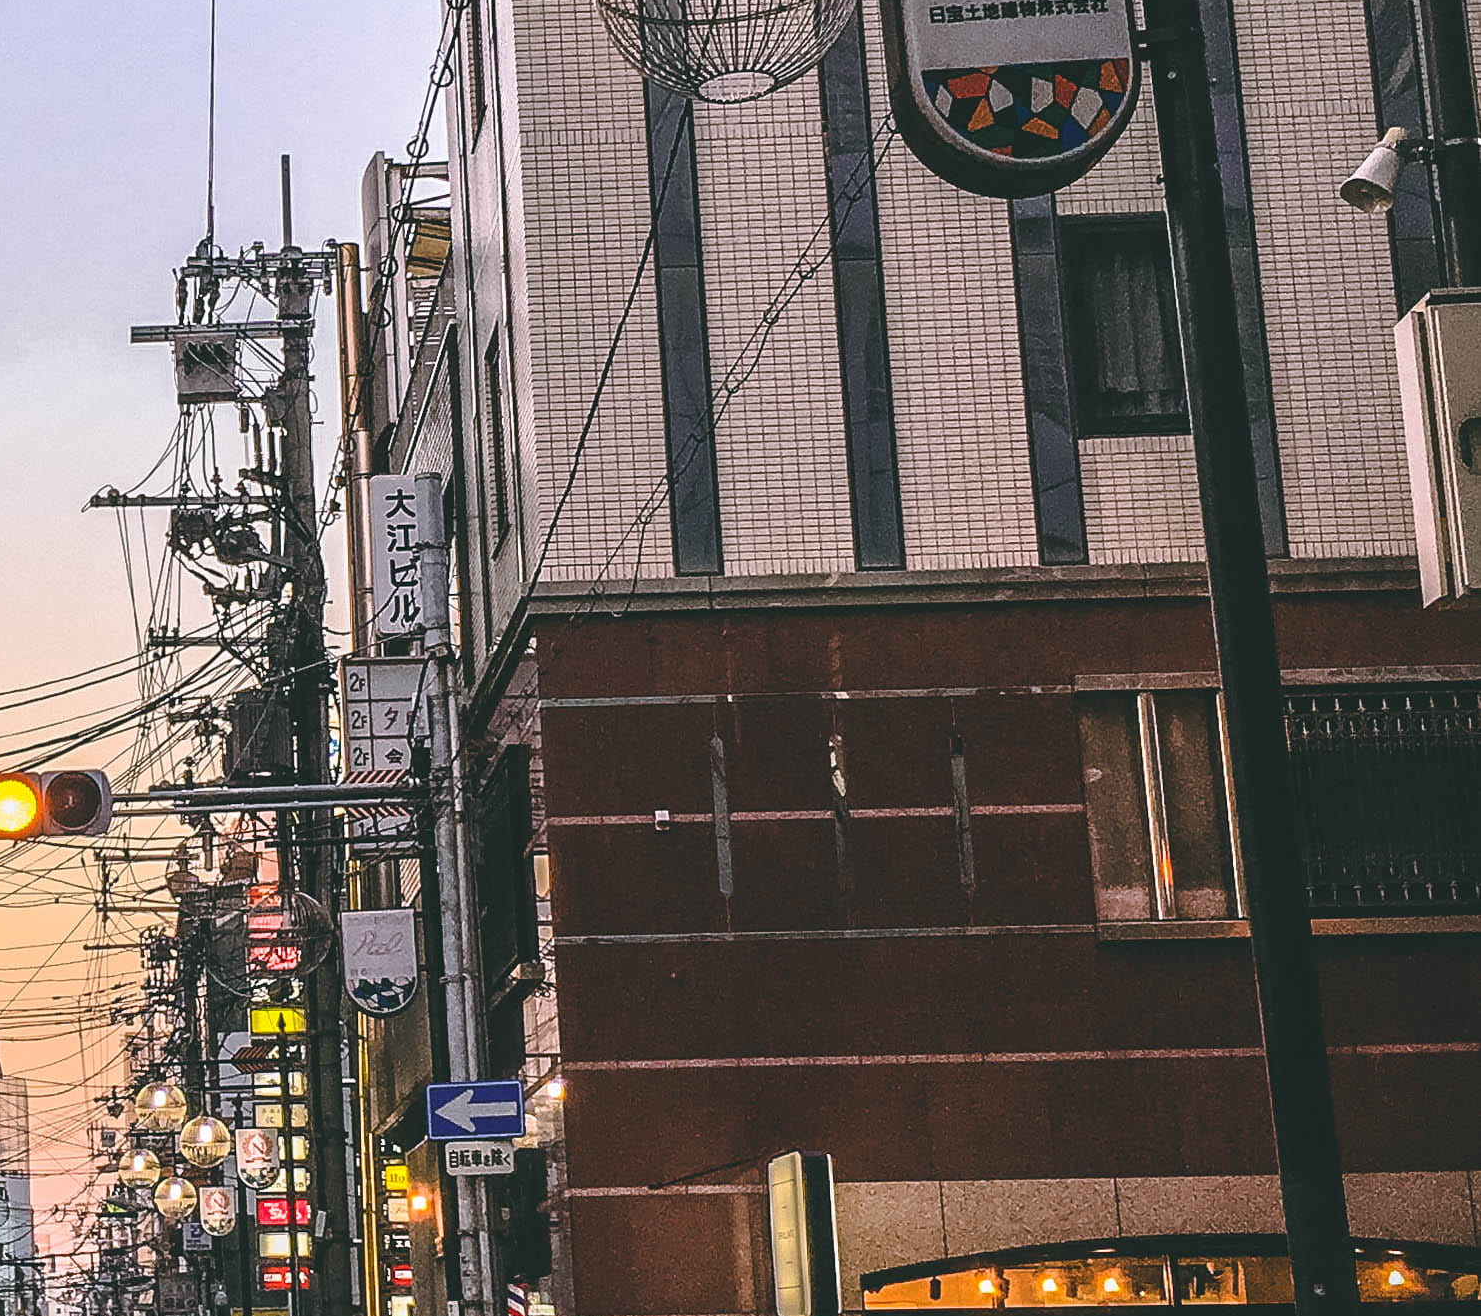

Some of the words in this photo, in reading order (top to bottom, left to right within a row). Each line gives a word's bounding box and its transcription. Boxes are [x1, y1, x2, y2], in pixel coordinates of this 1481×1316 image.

[385, 488, 421, 625] 大江ビル
[349, 672, 366, 692] 2F
[351, 710, 368, 730] 2F
[353, 746, 370, 766] 2F
[449, 1148, 511, 1168] 自転車を除く
